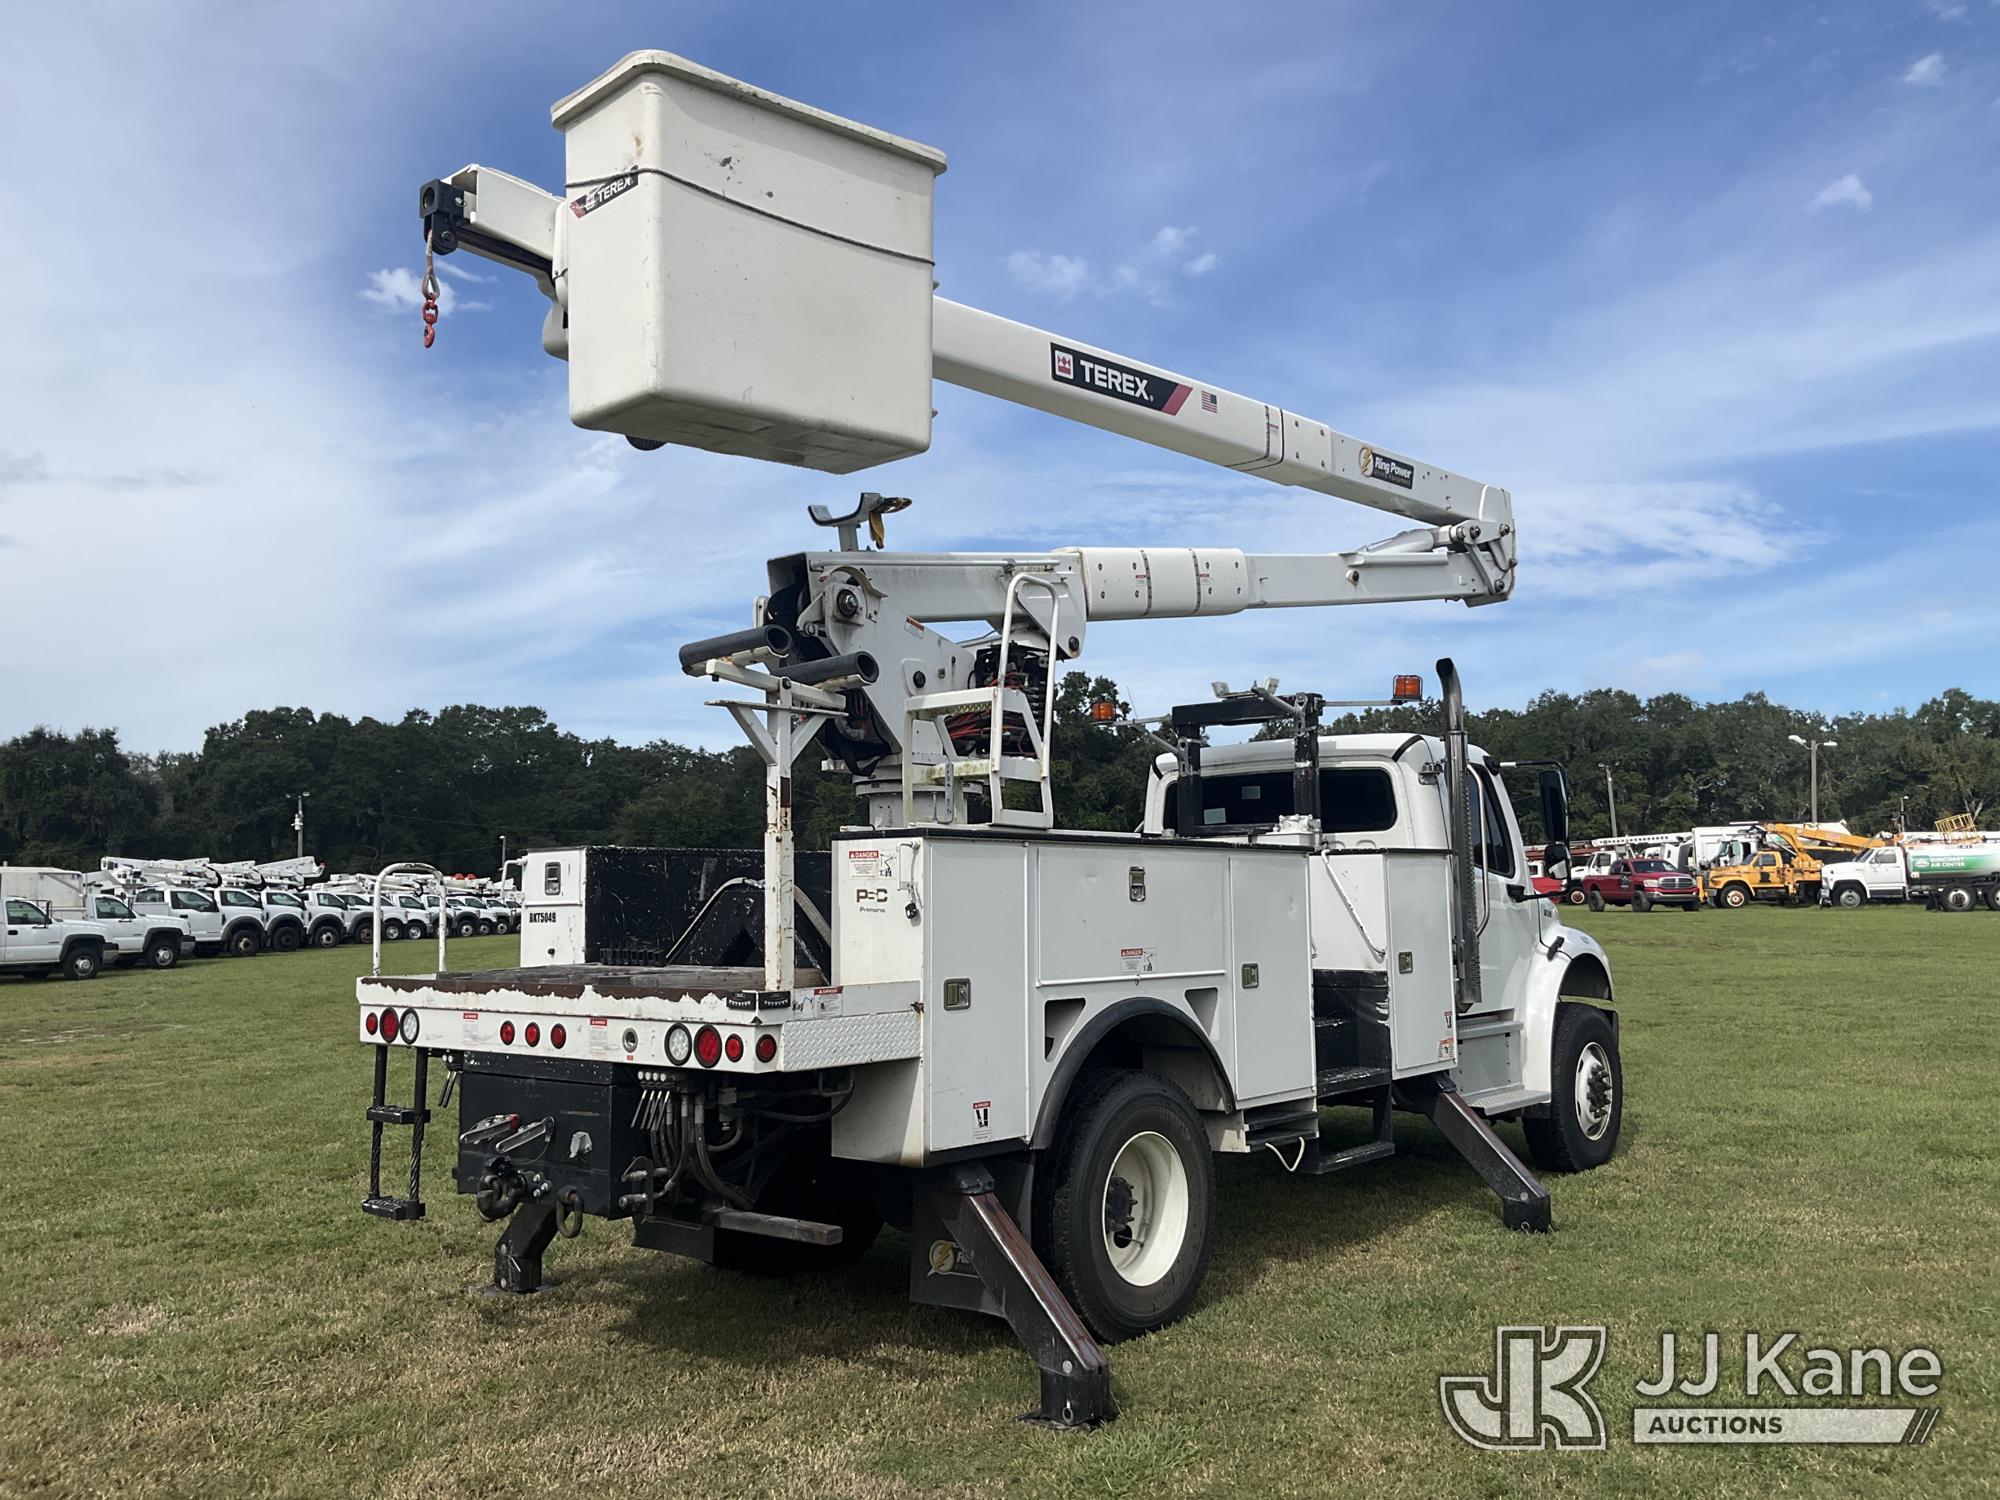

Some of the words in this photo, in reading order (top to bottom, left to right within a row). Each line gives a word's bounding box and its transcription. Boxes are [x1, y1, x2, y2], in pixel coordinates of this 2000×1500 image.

[598, 177, 632, 202] TEREX
[1080, 360, 1149, 400] TEREX
[1375, 457, 1390, 474] Ring
[1390, 462, 1412, 479] Power
